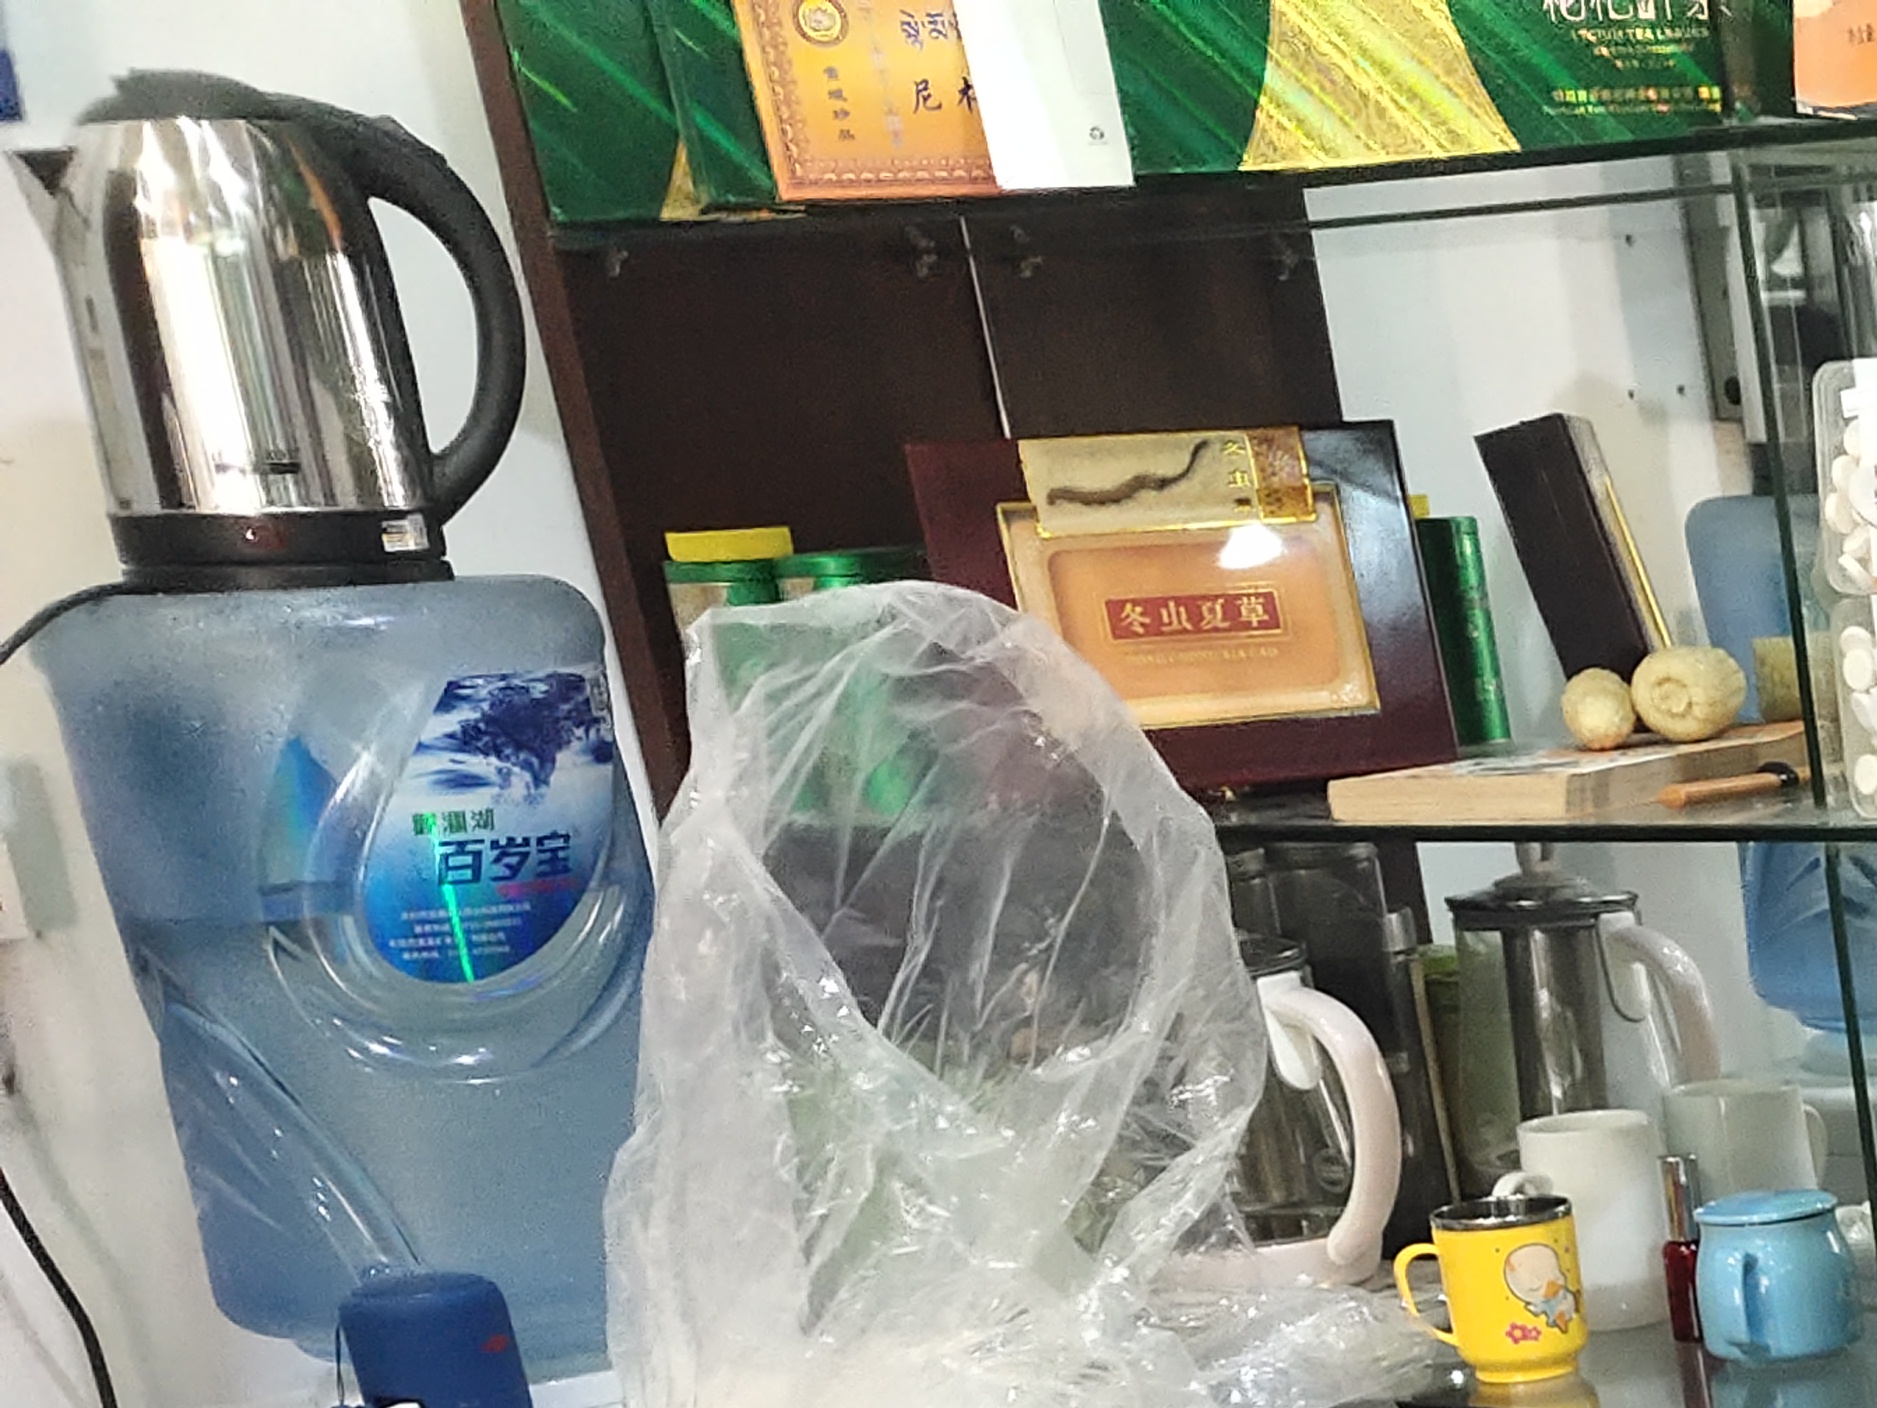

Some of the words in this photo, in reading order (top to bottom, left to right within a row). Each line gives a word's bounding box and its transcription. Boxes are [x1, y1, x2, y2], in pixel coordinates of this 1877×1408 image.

[1120, 597, 1269, 634] 冬虫夏草
[438, 830, 572, 886] 百岁宝
